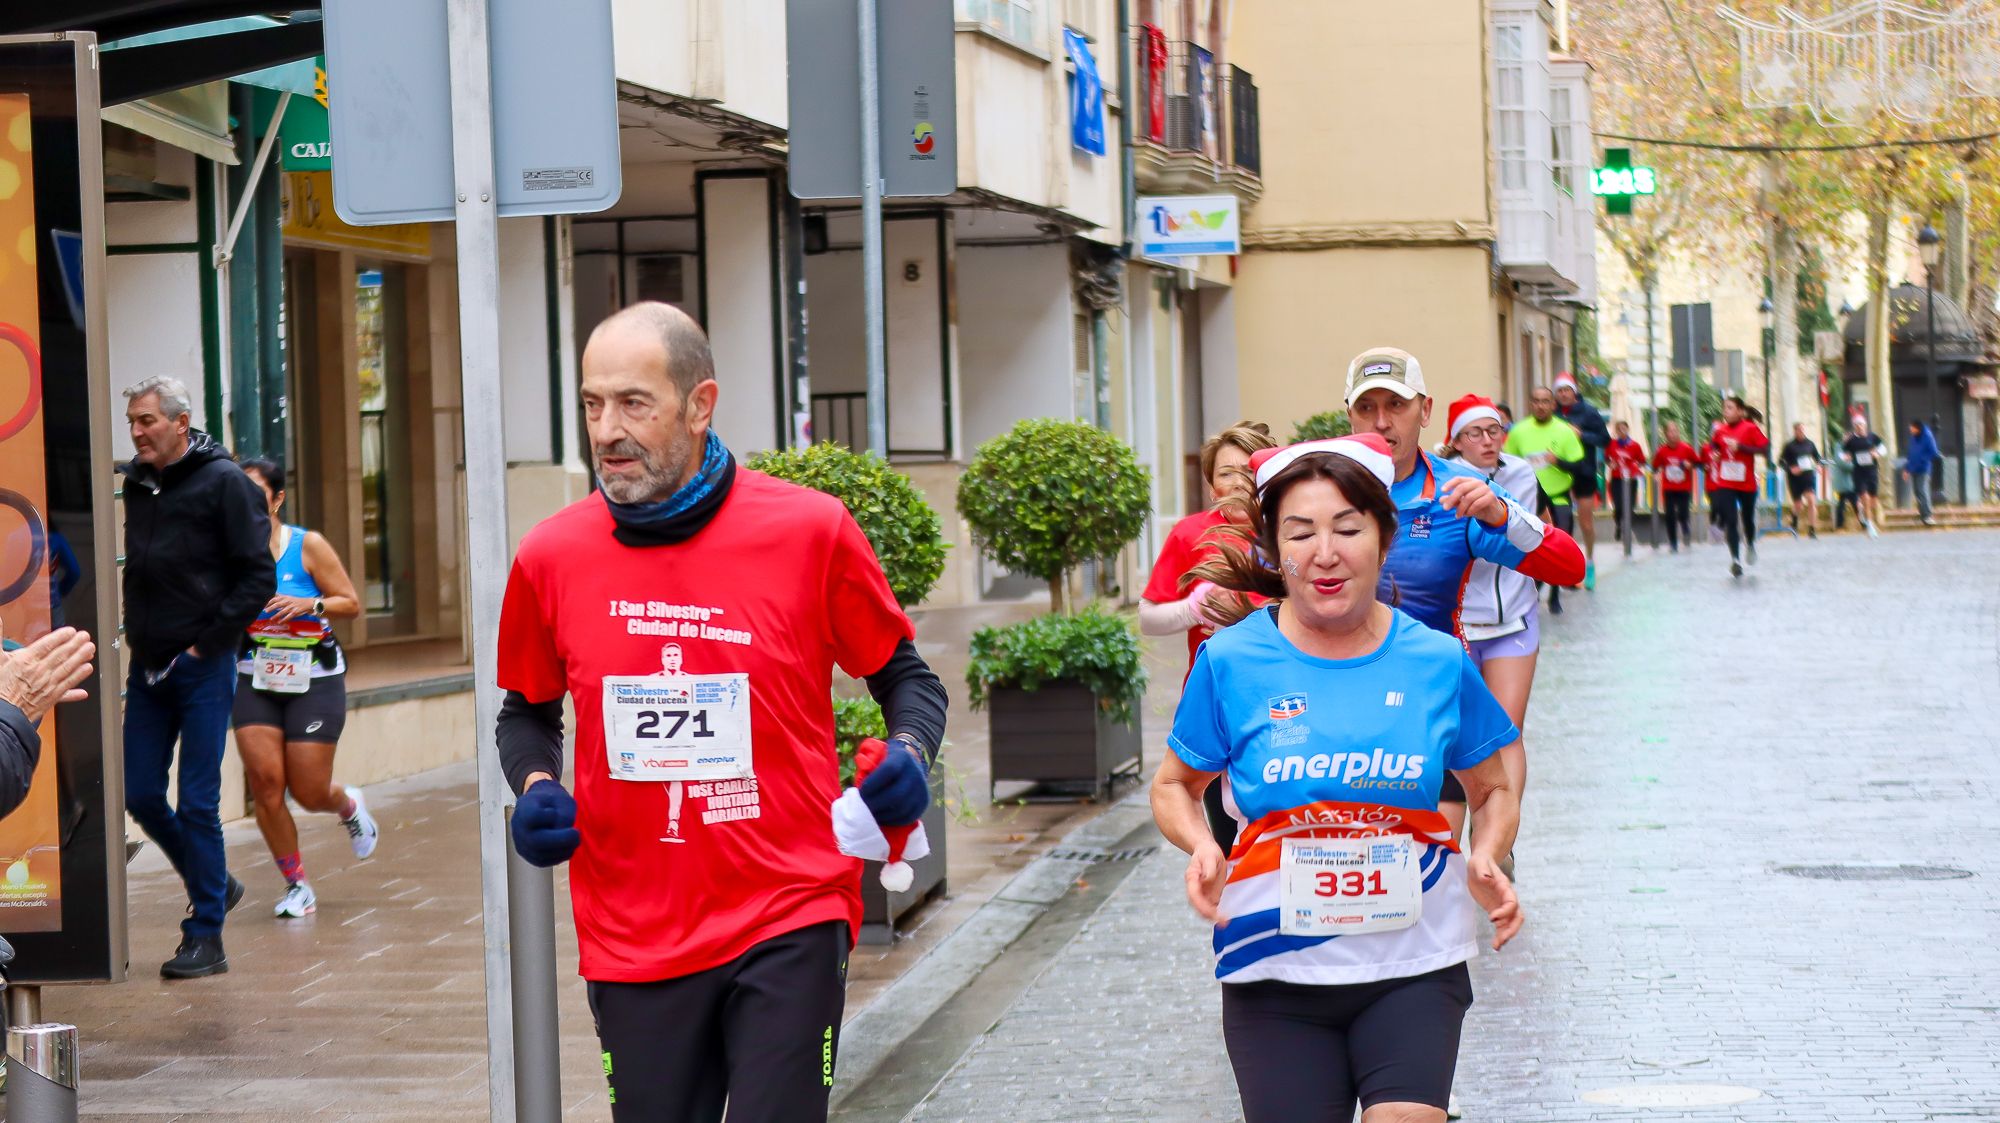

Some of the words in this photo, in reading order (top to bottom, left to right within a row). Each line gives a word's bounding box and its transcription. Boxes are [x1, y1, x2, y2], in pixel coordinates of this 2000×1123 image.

[904, 263, 920, 282] 8
[618, 600, 645, 617] San
[646, 600, 711, 621] Silvestre
[627, 618, 678, 637] Ciudad
[679, 621, 699, 638] de
[700, 623, 752, 646] Lucena
[265, 662, 296, 676] 371
[617, 687, 632, 696] San
[633, 687, 669, 696] Silvestre
[617, 696, 644, 704] Ciudad
[645, 696, 656, 704] de
[657, 697, 688, 705] Lucena
[636, 709, 715, 739] 271
[697, 756, 737, 765] enerplus
[1262, 748, 1424, 784] enerplus
[714, 779, 758, 795] CARLOS
[1350, 777, 1418, 791] directo
[707, 791, 760, 810] HURTADO
[1297, 849, 1312, 857] San
[1313, 848, 1348, 858] Silvestre
[1296, 857, 1323, 866] Ciudad
[1324, 858, 1335, 866] de
[1336, 858, 1365, 866] Lucena
[1314, 870, 1388, 897] 331
[1371, 911, 1407, 920] enerplus
